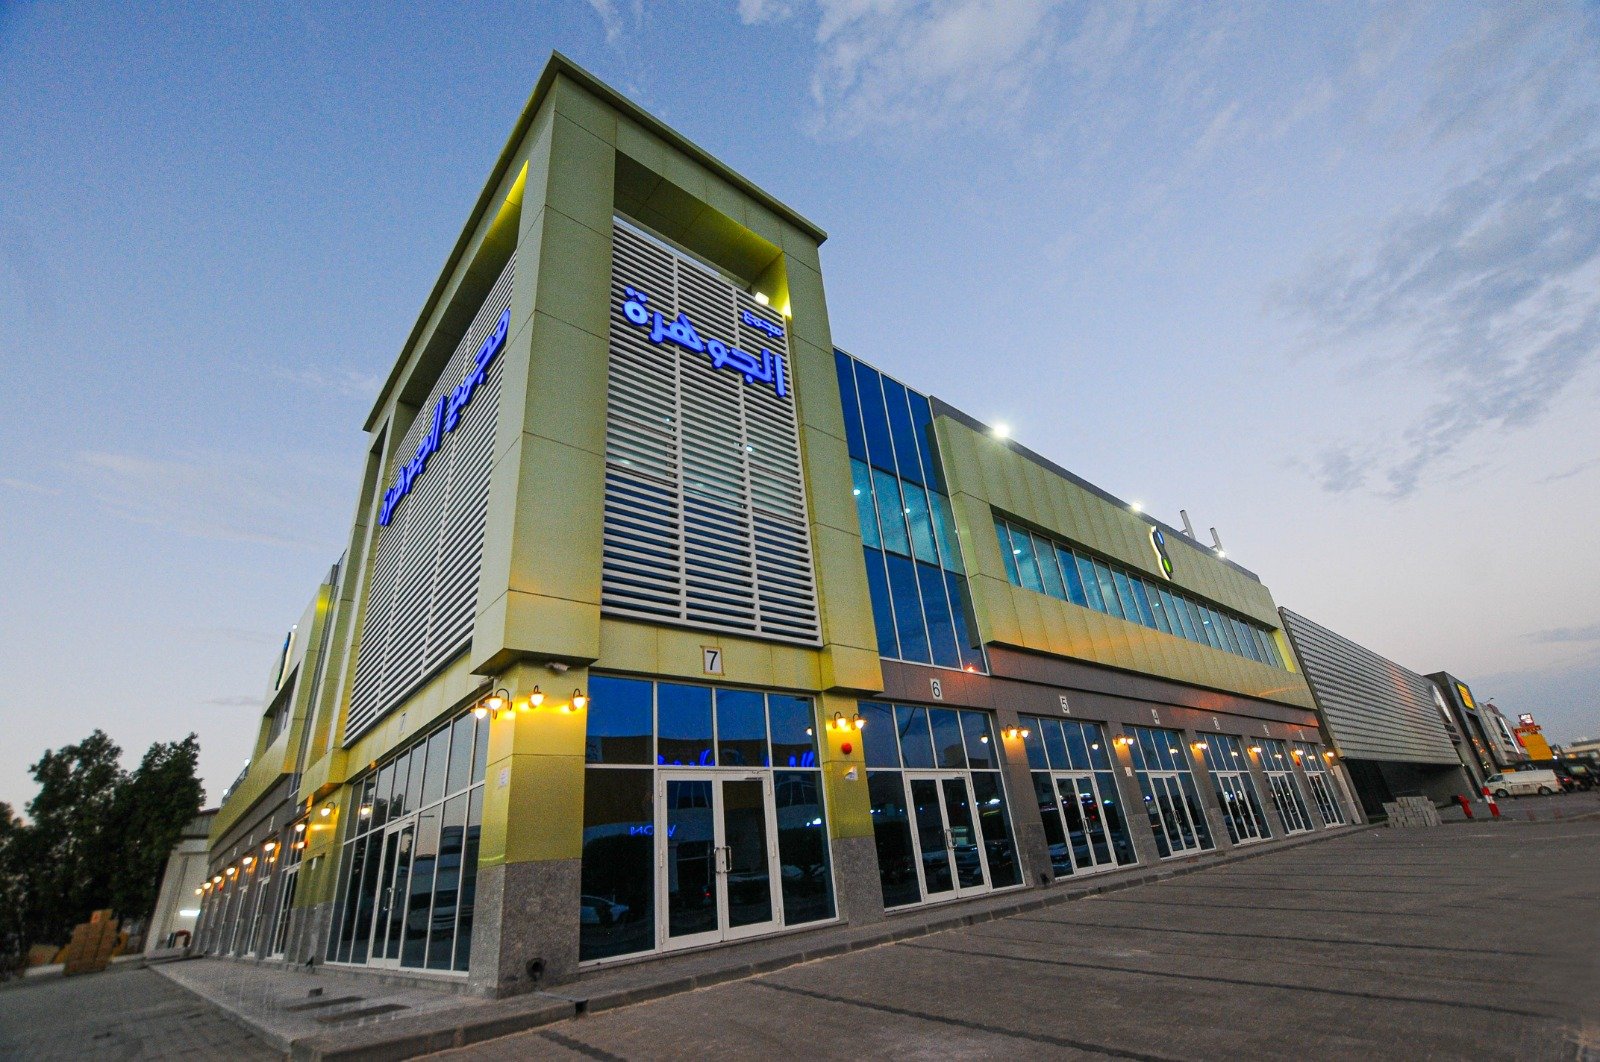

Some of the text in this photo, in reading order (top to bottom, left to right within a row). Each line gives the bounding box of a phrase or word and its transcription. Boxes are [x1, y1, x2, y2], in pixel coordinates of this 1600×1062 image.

[742, 310, 784, 338] مجمع
[622, 286, 787, 397] الجوهرة
[706, 650, 719, 671] 7
[932, 681, 941, 698] 6
[1061, 698, 1069, 712] 5
